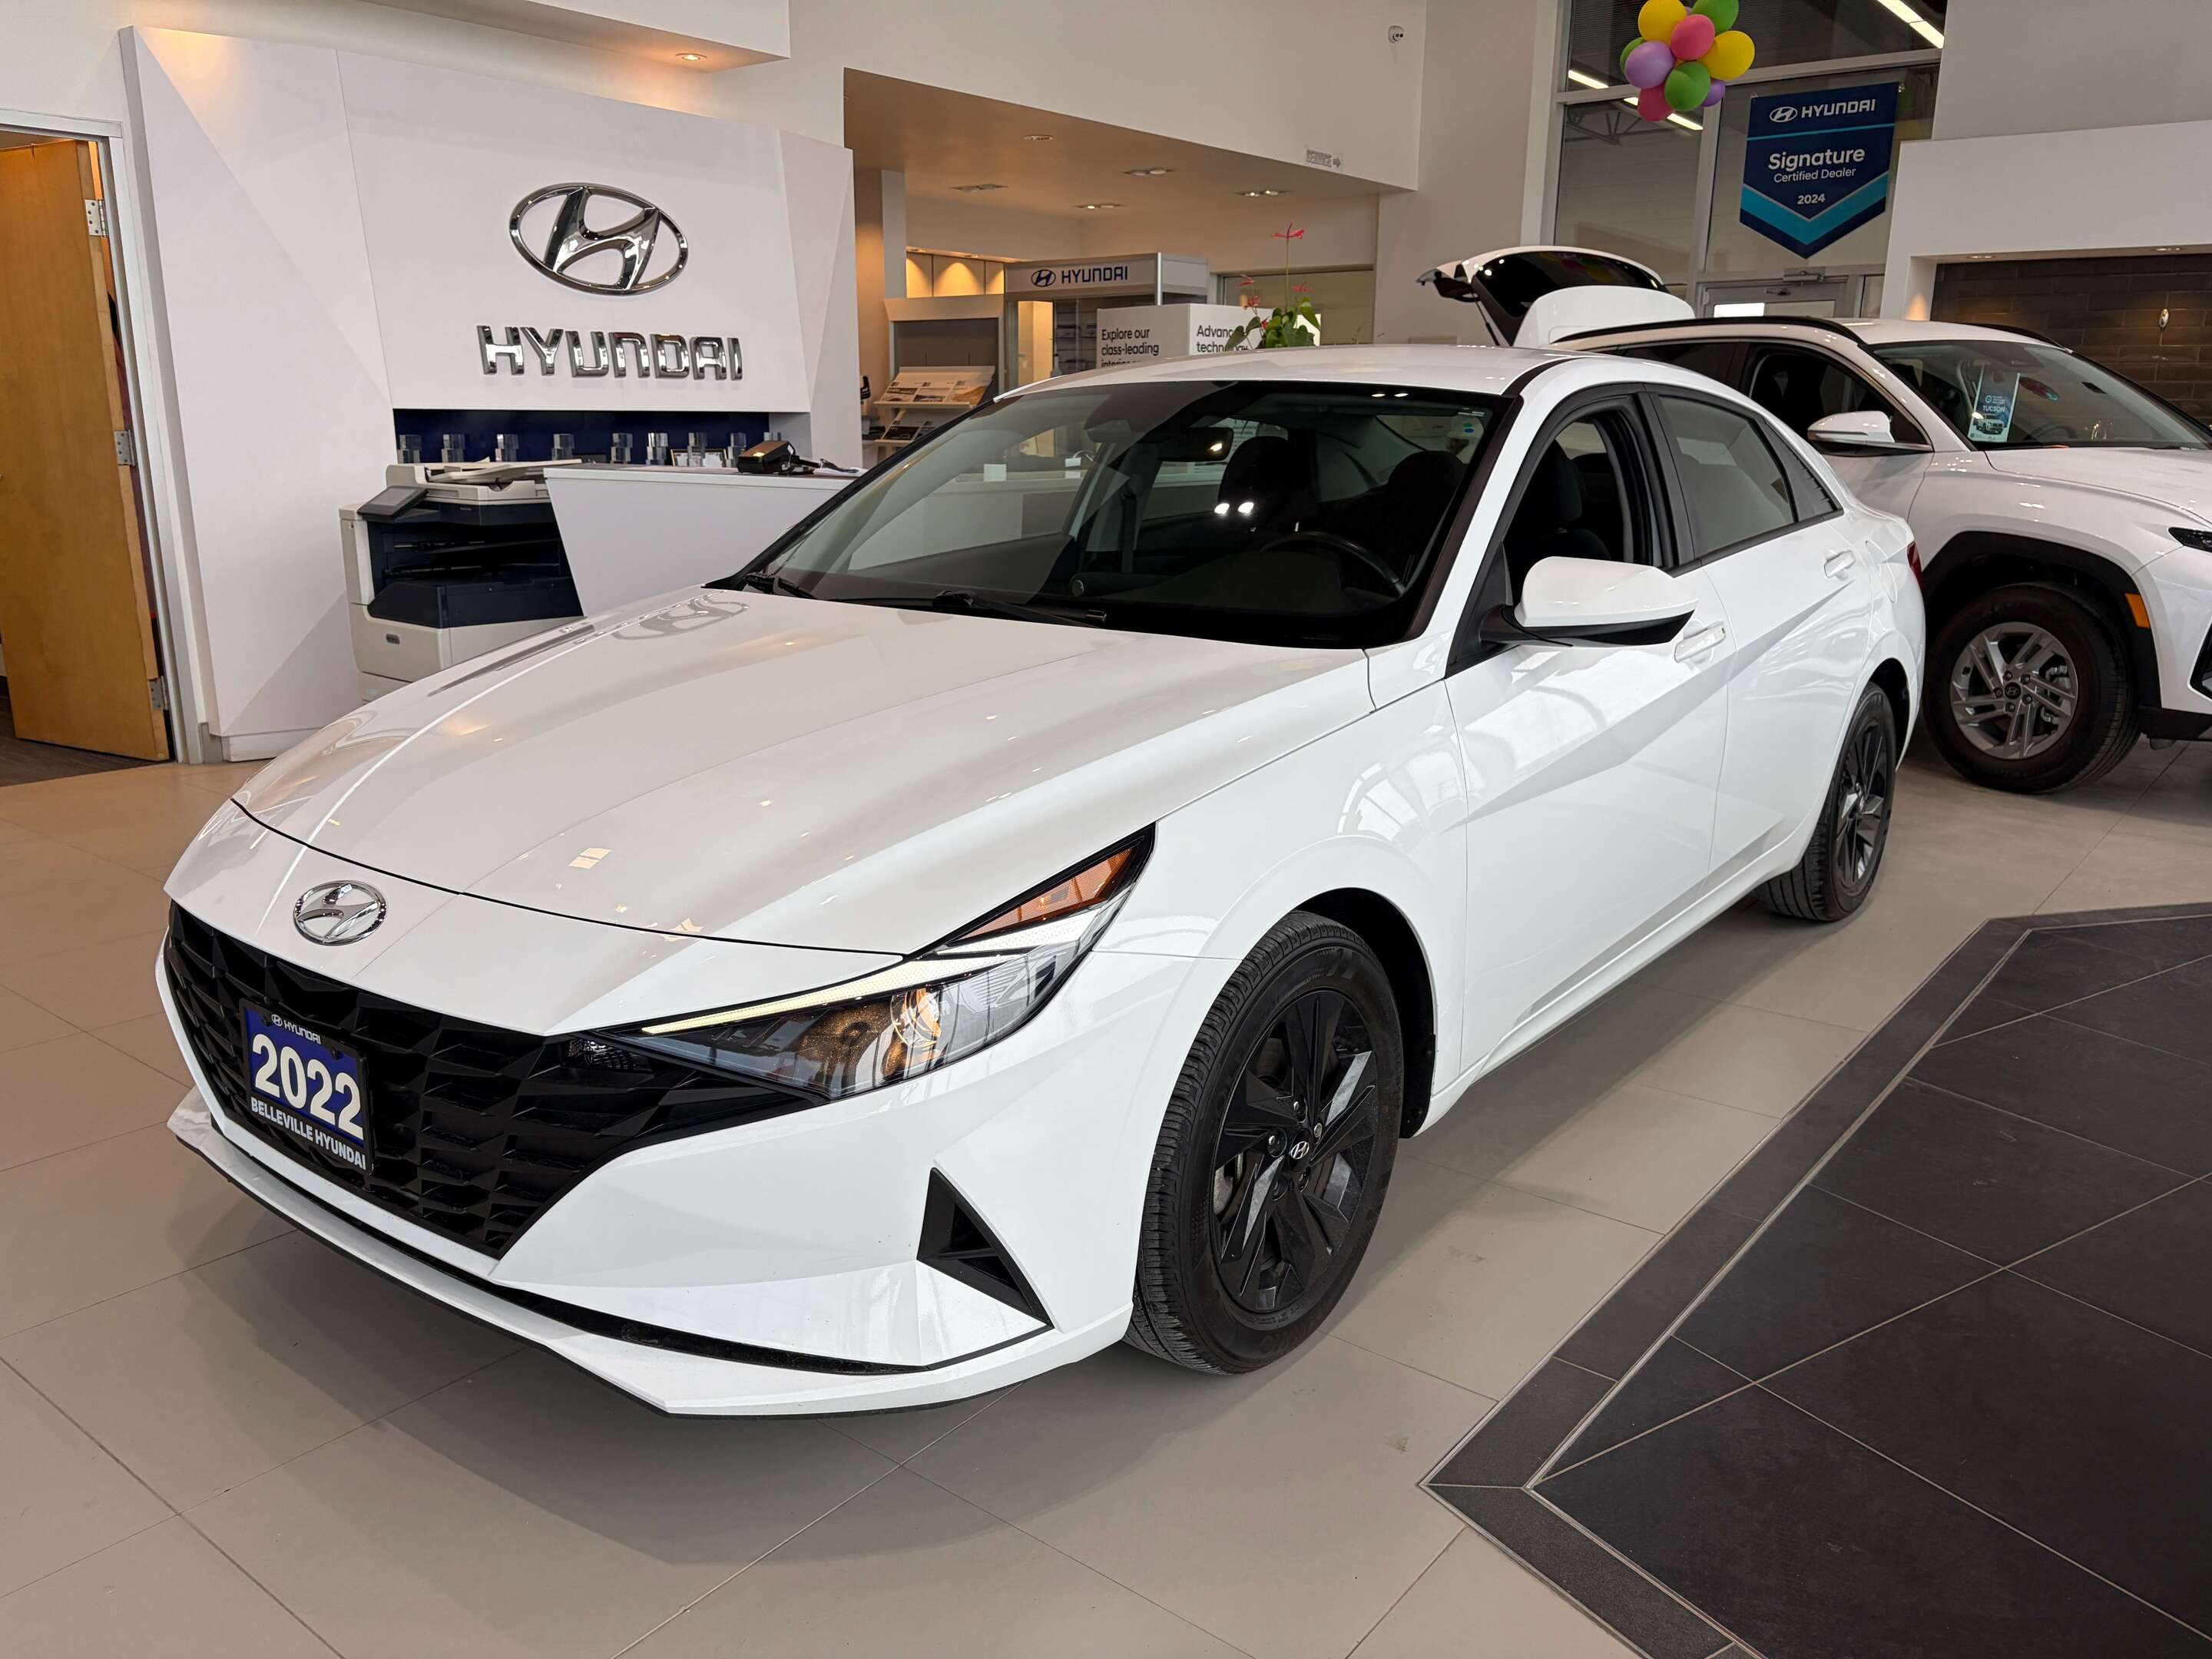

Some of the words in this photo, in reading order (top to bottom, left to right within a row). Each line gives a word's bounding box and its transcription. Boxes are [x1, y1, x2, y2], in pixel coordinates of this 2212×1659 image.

[1801, 98, 1876, 118] HYUNDAI
[1768, 148, 1866, 172] Signature
[1773, 170, 1819, 183] Certified
[1821, 167, 1856, 179] Dealer
[1797, 193, 1826, 205] 2024
[1061, 266, 1128, 284] HYUNDAI
[1101, 328, 1133, 343] Explore
[1134, 329, 1151, 339] our
[1197, 325, 1234, 338] Advanc
[476, 325, 743, 380] HYUNDAI
[1101, 341, 1159, 356] class-leading
[283, 1019, 321, 1045] HYUNDAI
[253, 1034, 364, 1141] 2022
[250, 1096, 314, 1141] BELLEVILLE
[315, 1128, 366, 1171] HYUNDAI
